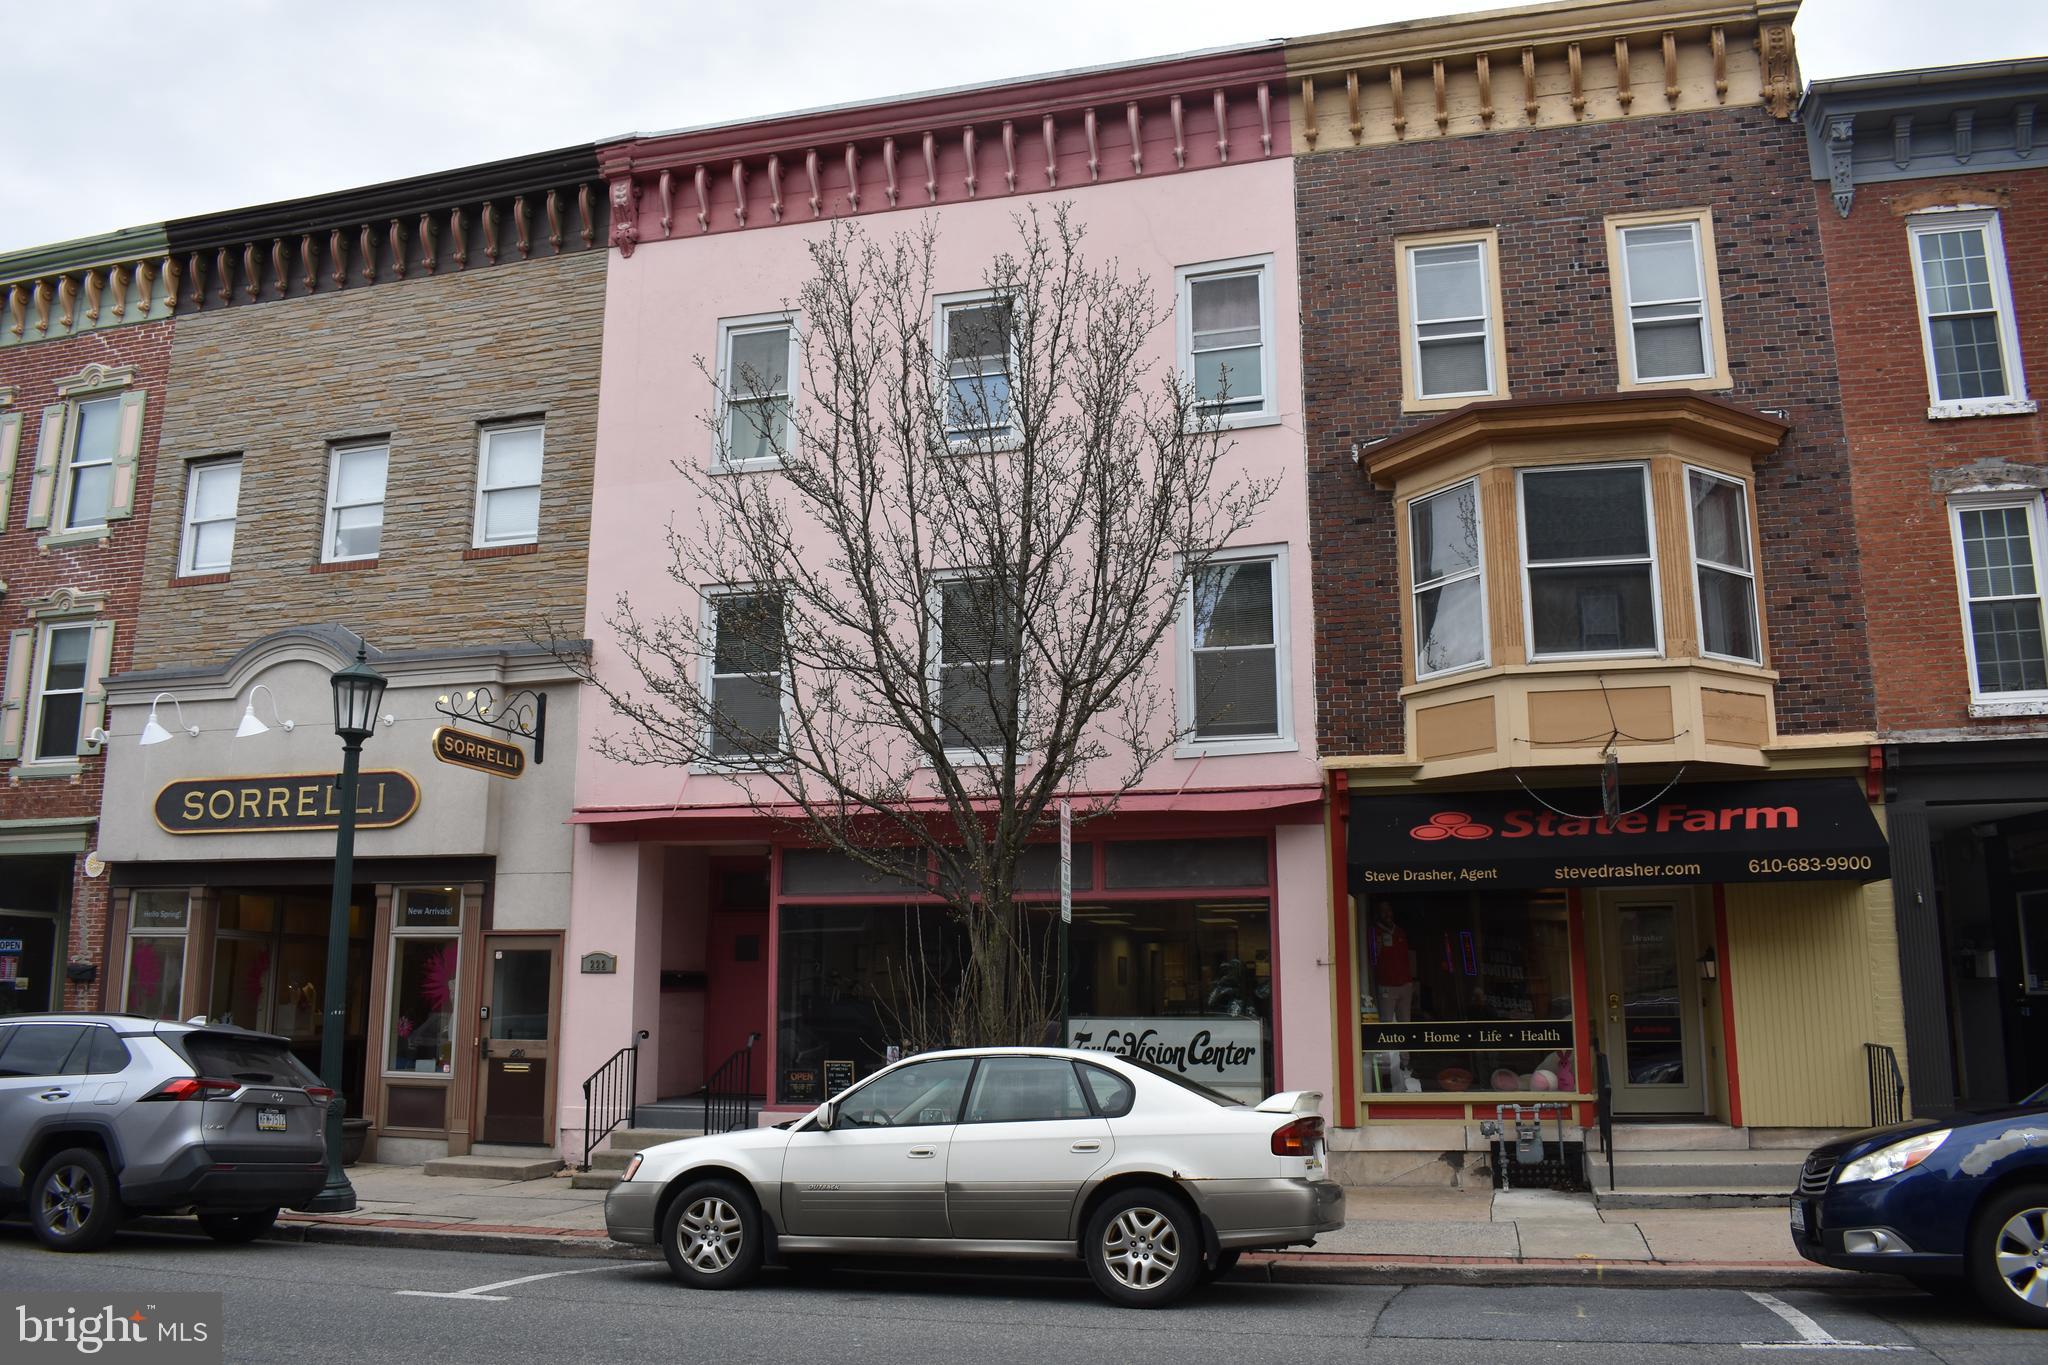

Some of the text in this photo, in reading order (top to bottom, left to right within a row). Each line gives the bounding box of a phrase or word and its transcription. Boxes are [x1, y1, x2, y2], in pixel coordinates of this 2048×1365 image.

[444, 736, 518, 768] SORRELLI
[182, 782, 386, 820] SORRELLI
[1501, 804, 1799, 838] State Farm
[1554, 862, 1701, 880] stevedrasher.com
[1748, 855, 1872, 873] 610-683-9900
[1364, 867, 1498, 882] Steve Drasher, Agent
[408, 906, 453, 915] New Arrivals!
[0, 941, 21, 950] OPEN
[590, 959, 607, 971] 222
[1377, 1029, 1561, 1043] Auto Home Life Health
[1123, 1029, 1188, 1073] Vision
[1188, 1030, 1256, 1073] Center
[790, 1072, 814, 1081] OPEN
